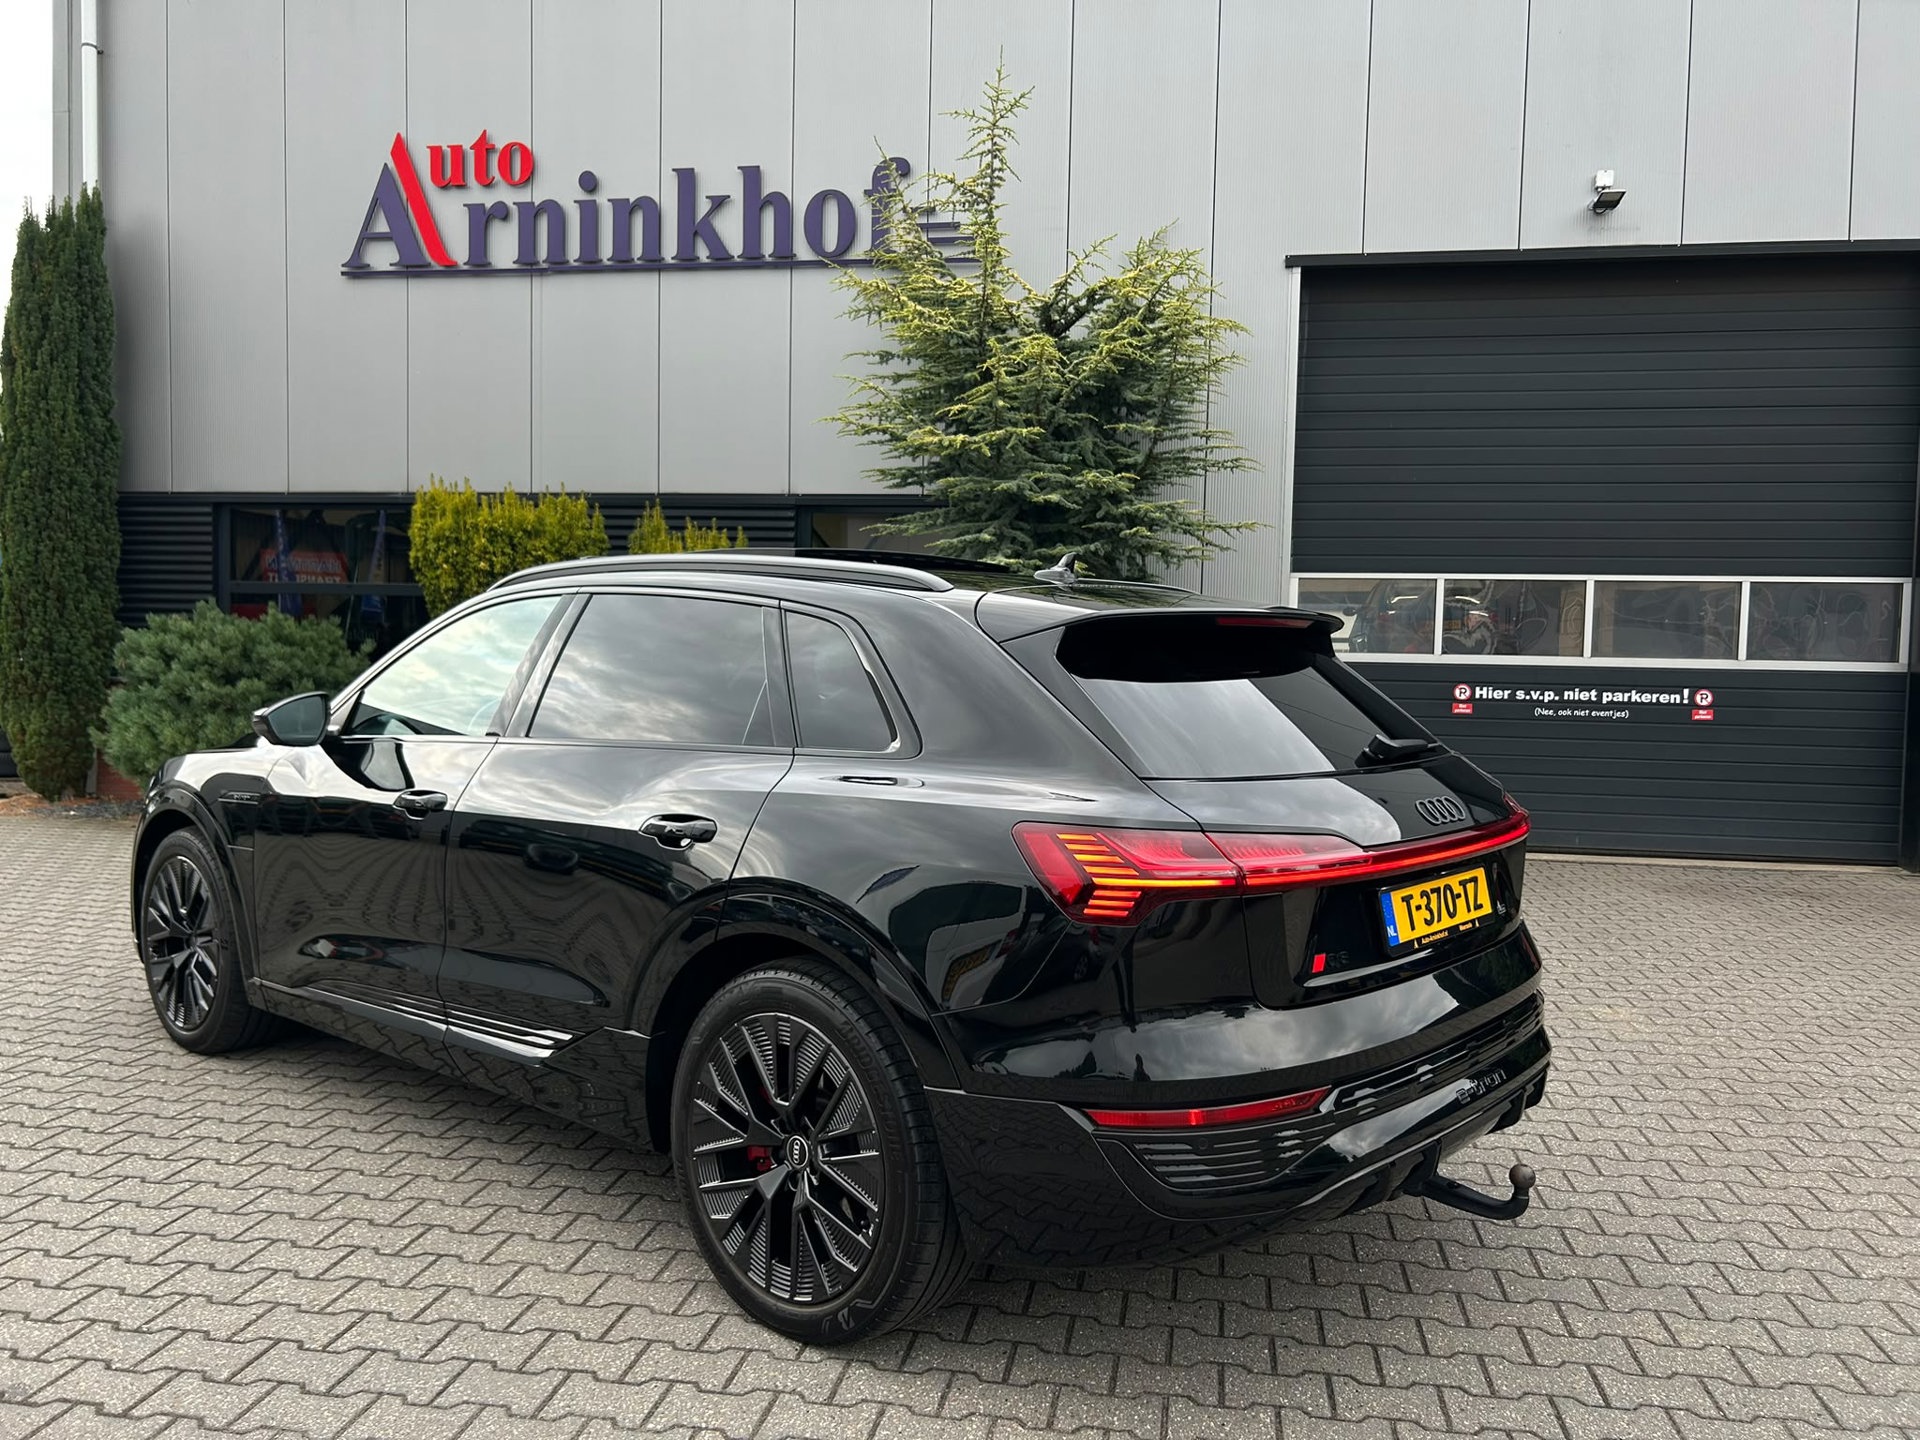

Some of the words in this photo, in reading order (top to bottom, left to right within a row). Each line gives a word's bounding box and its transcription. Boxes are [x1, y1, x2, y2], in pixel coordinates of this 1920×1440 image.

[341, 155, 911, 268] Arninkhof
[1475, 686, 1511, 699] Hier
[1515, 689, 1559, 702] s.v.p.
[1564, 688, 1597, 700] niet
[1602, 688, 1689, 704] parkeren!
[1534, 707, 1556, 716] (Nee,
[1558, 708, 1572, 716] ook
[1591, 709, 1629, 719] eventjes)
[1401, 876, 1483, 931] T-370-TZ
[1387, 925, 1397, 937] NL
[1456, 1068, 1507, 1104] e-tron
